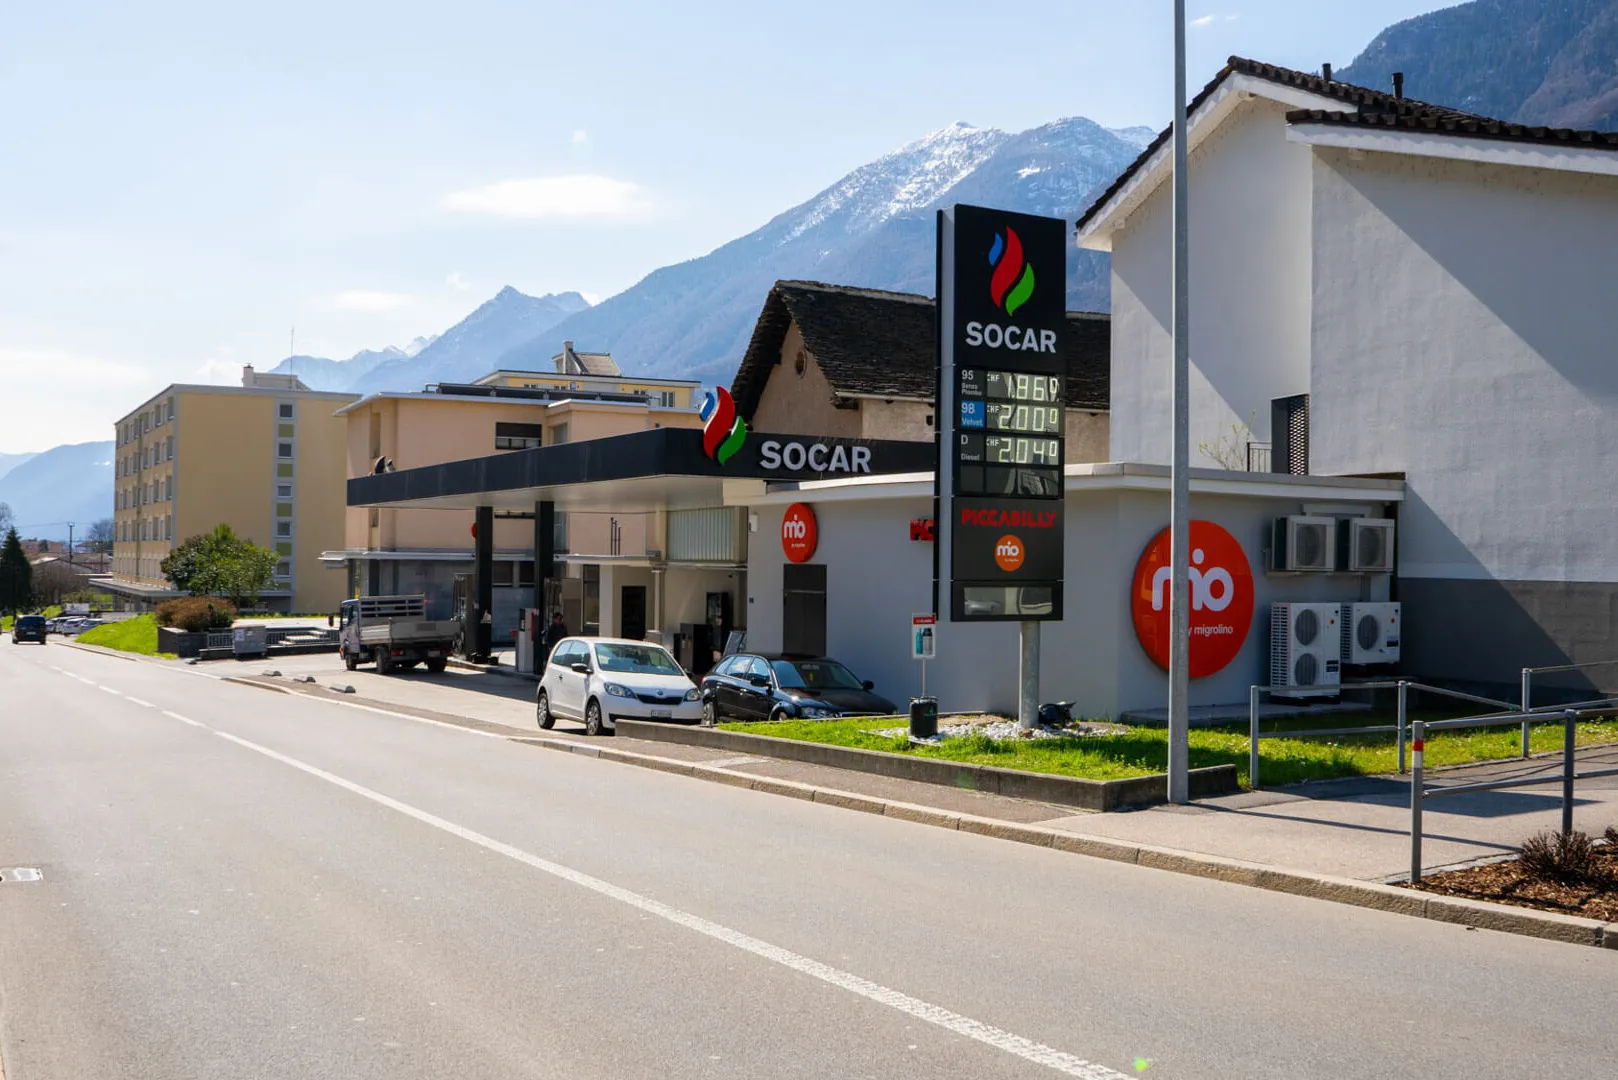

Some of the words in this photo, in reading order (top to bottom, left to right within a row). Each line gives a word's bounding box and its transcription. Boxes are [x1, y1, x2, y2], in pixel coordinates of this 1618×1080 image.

[965, 321, 1057, 353] SOCAR
[961, 370, 974, 380] 95
[961, 402, 975, 414] 98
[961, 435, 968, 445] D
[760, 440, 872, 473] SOCAR
[961, 453, 980, 461] Diesel
[783, 513, 806, 538] mio
[961, 509, 1057, 528] PICCADILLY
[997, 540, 1020, 556] mio
[1194, 624, 1234, 637] migrolino
